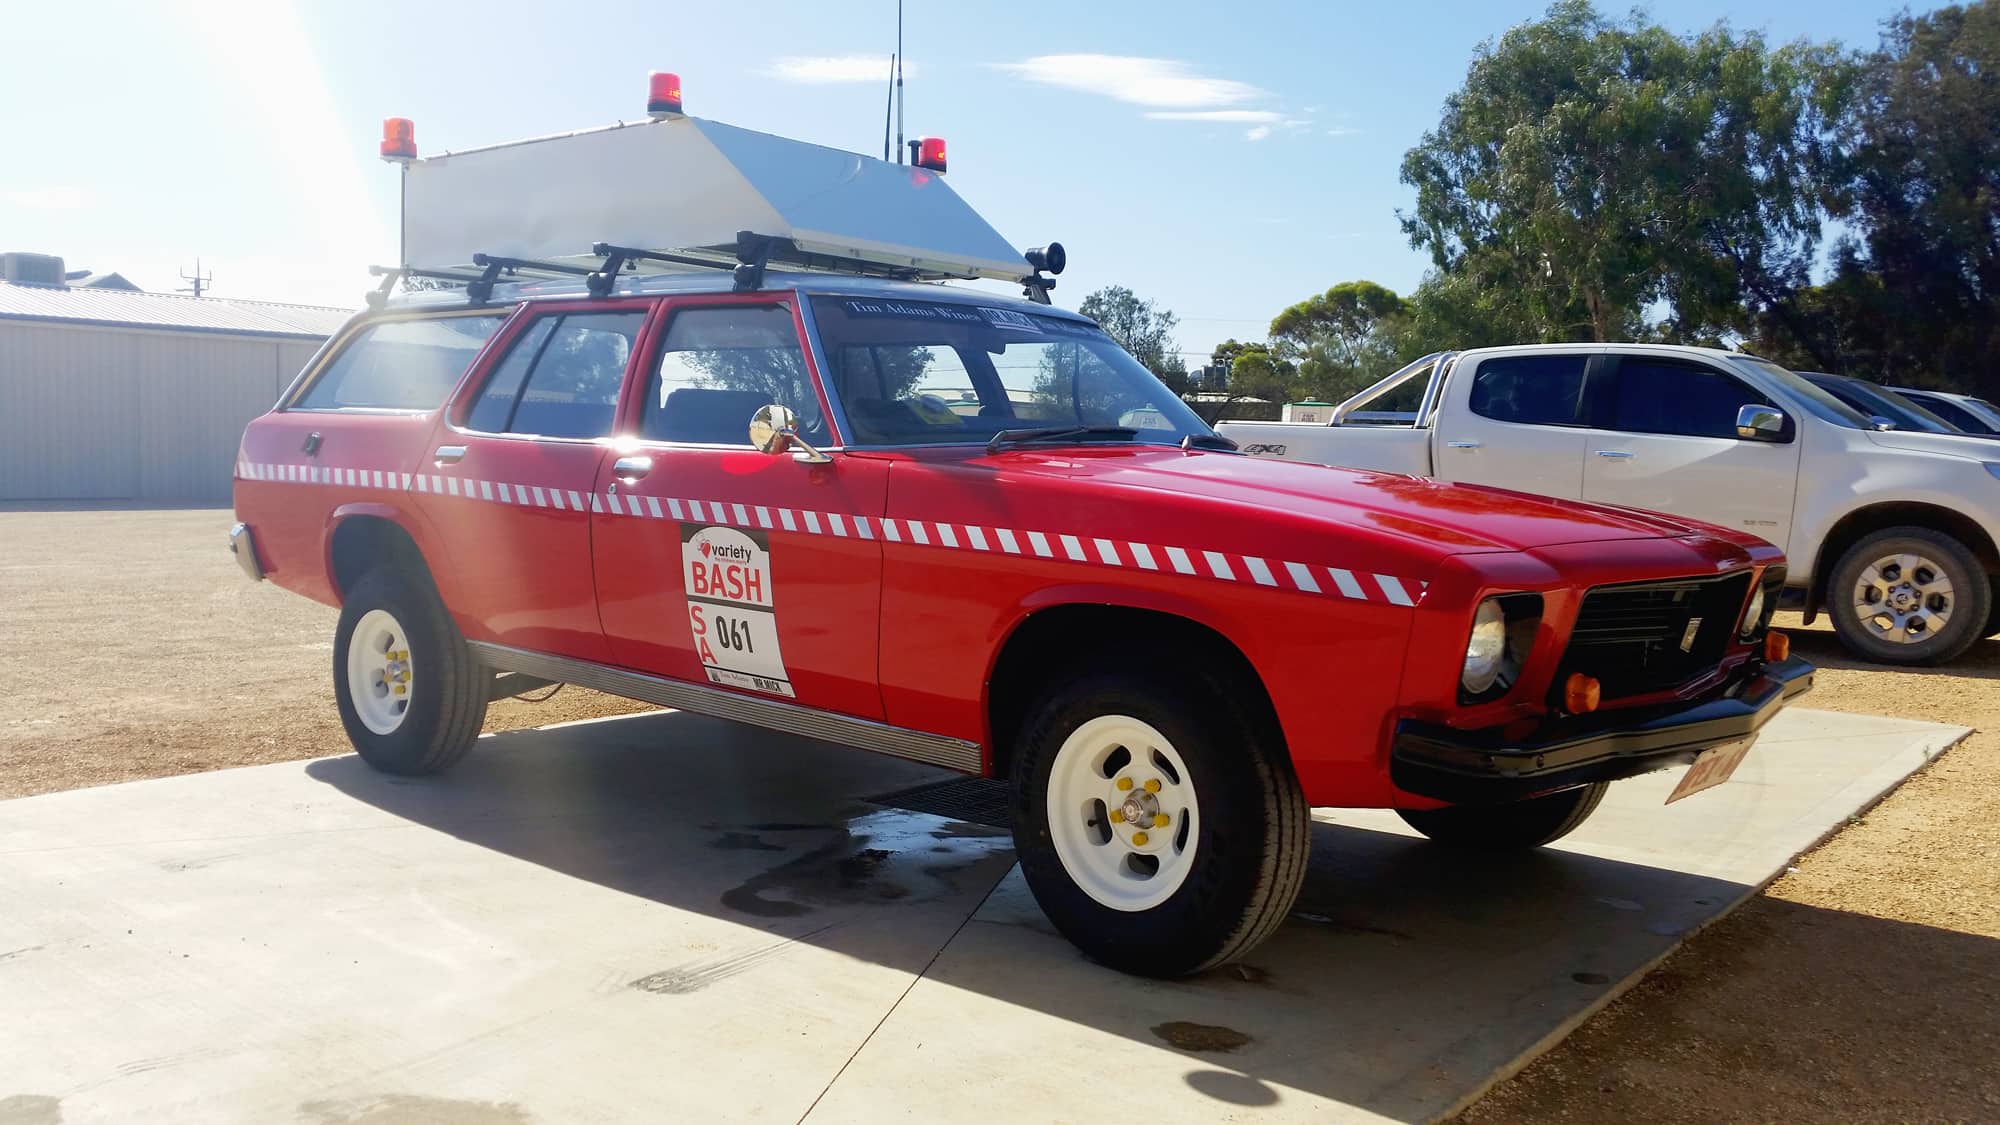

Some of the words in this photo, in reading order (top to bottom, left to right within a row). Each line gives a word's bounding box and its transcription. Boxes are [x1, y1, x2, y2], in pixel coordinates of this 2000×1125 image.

[846, 301, 882, 313] Tim
[886, 303, 936, 316] Adams
[934, 307, 981, 320] Wines
[711, 545, 752, 563] variety
[691, 561, 762, 602] BASH
[715, 615, 753, 653] 061
